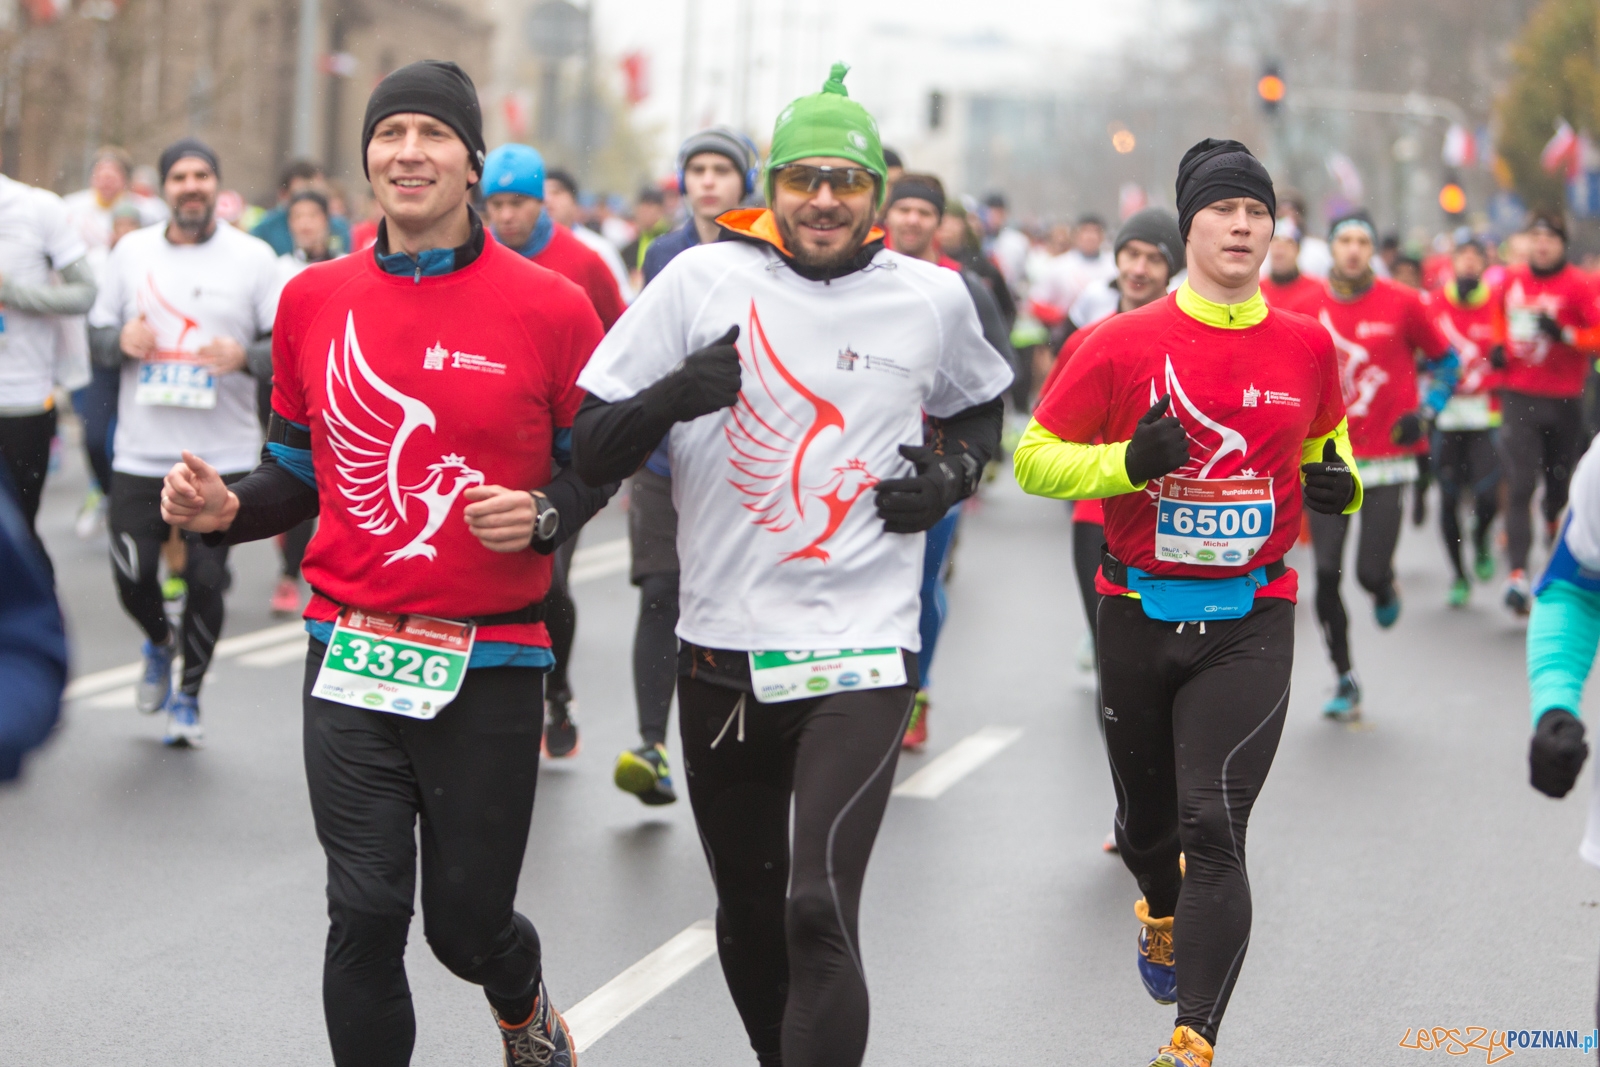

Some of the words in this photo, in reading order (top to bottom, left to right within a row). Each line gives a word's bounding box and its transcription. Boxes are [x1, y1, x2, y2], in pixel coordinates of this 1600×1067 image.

[1222, 488, 1264, 496] RunPoland.org
[1161, 512, 1169, 522] E
[1173, 507, 1262, 536] 6500
[405, 625, 463, 646] RunPoland.org
[343, 638, 450, 688] 3326
[377, 682, 399, 694] Piotr
